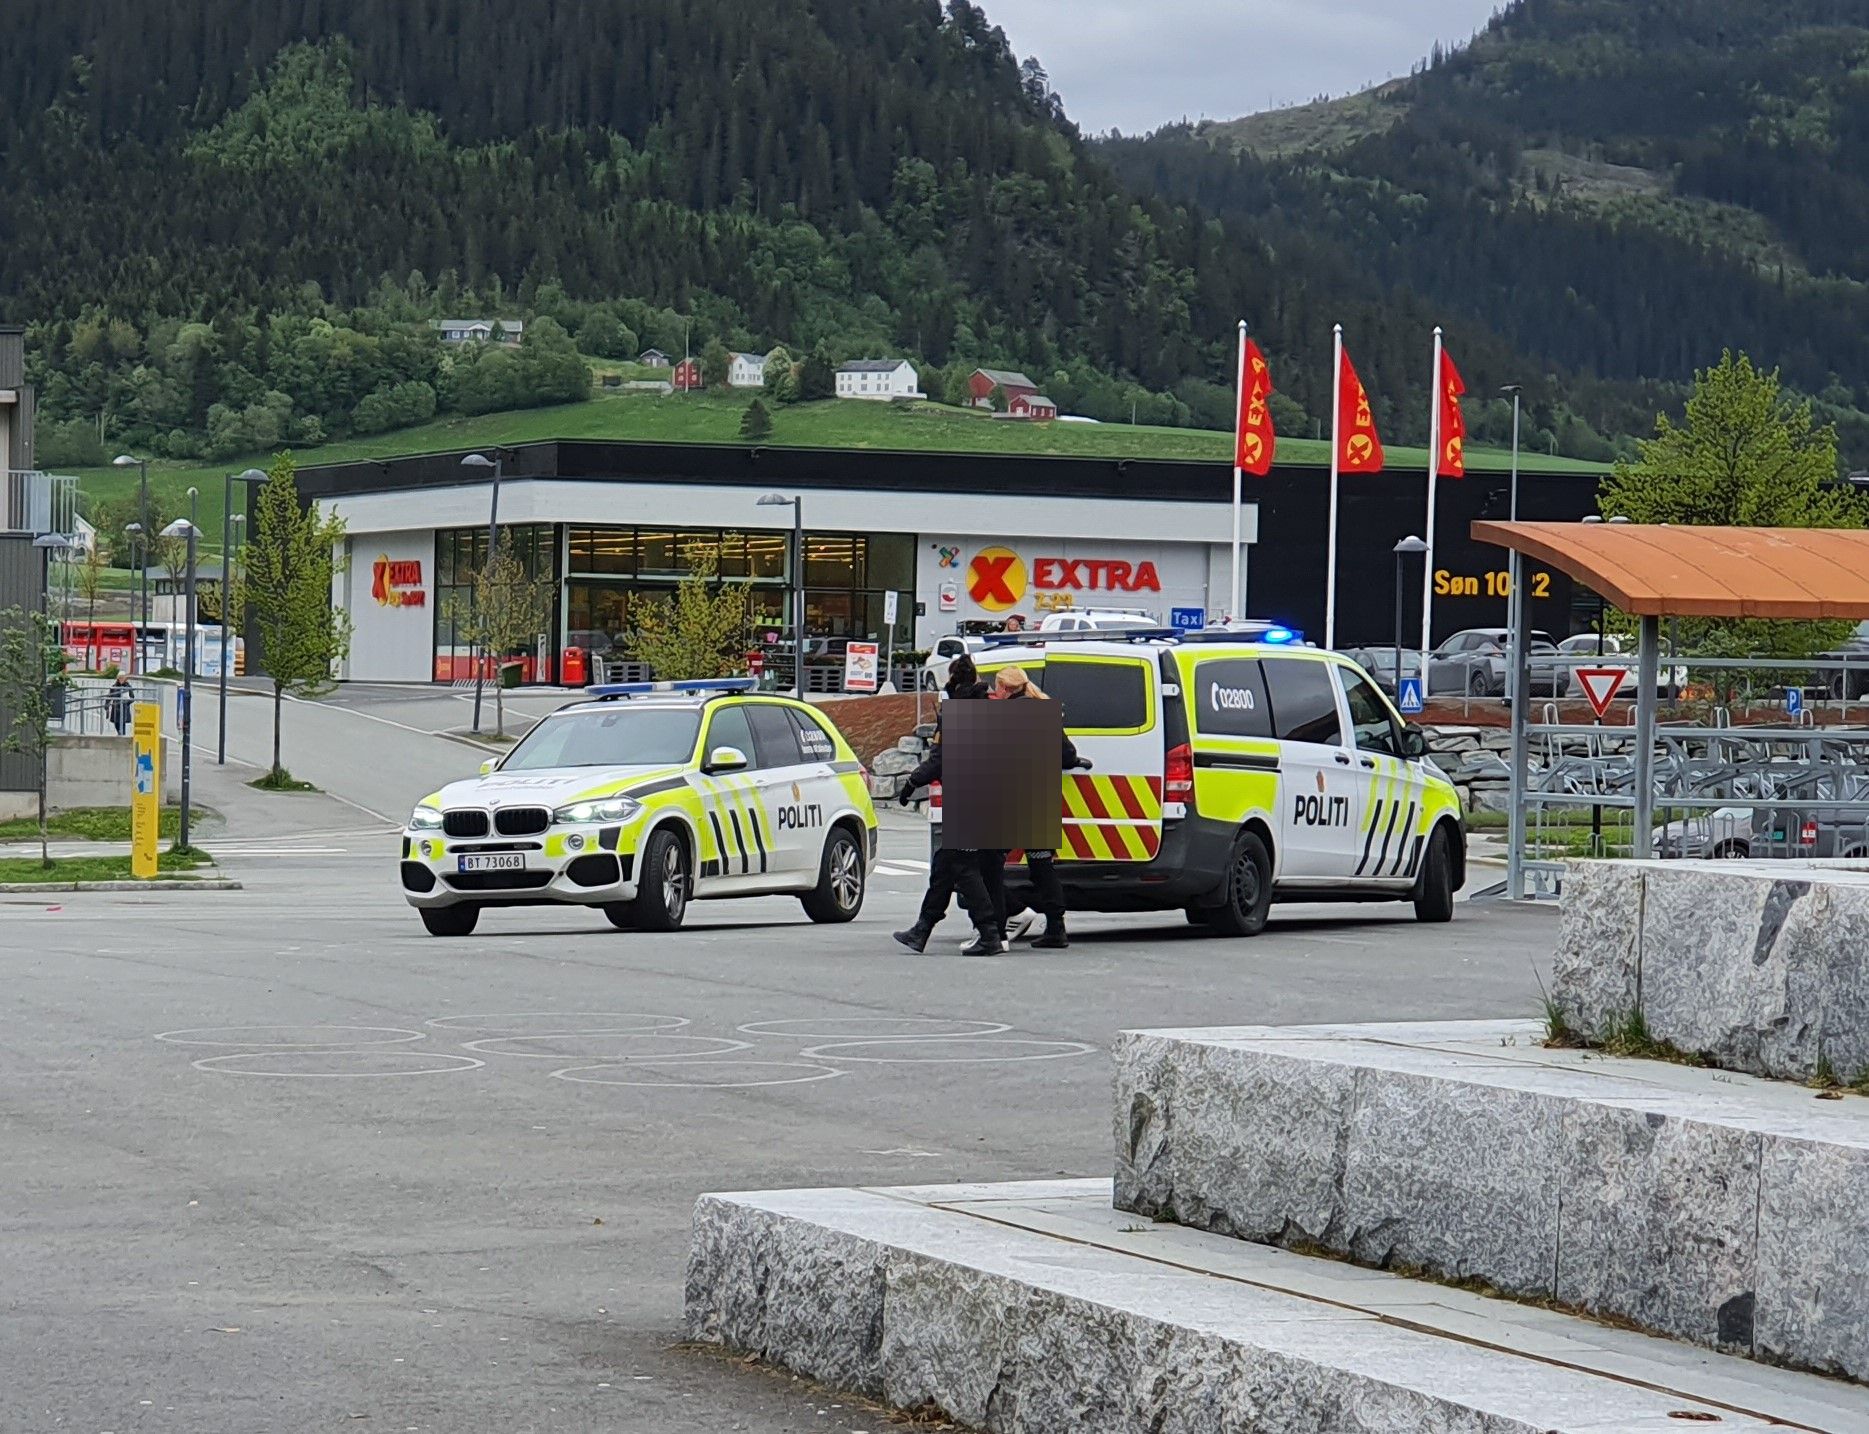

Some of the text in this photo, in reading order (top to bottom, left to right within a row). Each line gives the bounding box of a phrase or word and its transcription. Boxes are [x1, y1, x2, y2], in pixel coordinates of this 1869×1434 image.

[968, 554, 1161, 605] X EXTRA
[1434, 569, 1478, 595] Søn
[1172, 611, 1203, 626] Taxi
[1219, 688, 1255, 709] 02800
[1789, 691, 1797, 711] P
[778, 803, 822, 830] POLITI
[1293, 794, 1349, 827] POLITI
[467, 855, 520, 869] BT 73068
